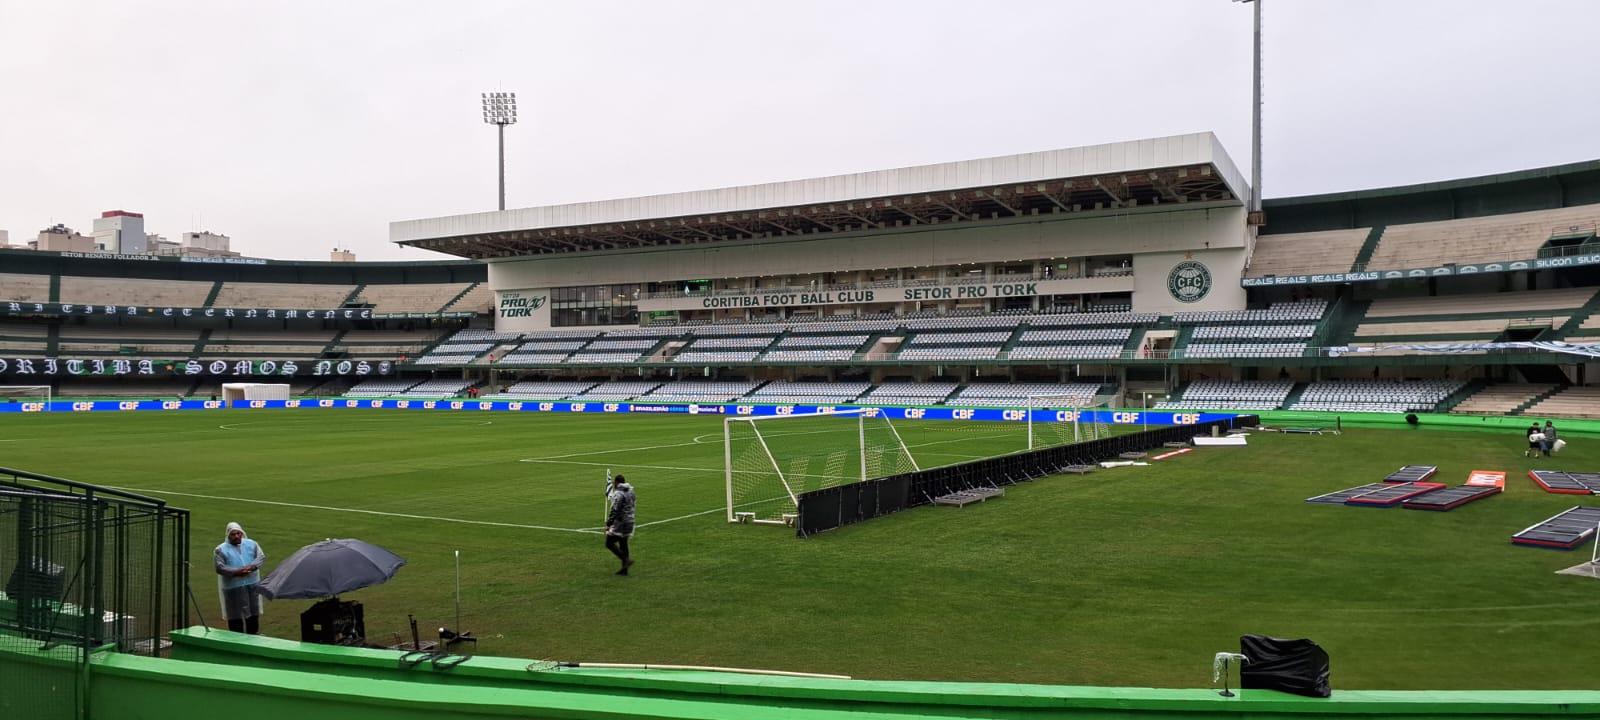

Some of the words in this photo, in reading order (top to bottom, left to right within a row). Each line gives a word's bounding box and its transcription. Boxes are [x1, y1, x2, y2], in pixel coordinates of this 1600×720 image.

[1242, 277, 1274, 286] REALS
[1275, 275, 1307, 284] REALS
[1311, 274, 1344, 283] REALS
[1345, 271, 1378, 281] REALS
[702, 296, 760, 308] CORITIBA
[763, 294, 797, 306] FOOT
[800, 292, 834, 304] BALL
[837, 290, 874, 303] CLUB
[904, 287, 951, 300] SETOR
[957, 285, 988, 298] PRO
[992, 283, 1038, 296] TORK
[500, 298, 527, 308] PRO
[500, 308, 532, 318] TORK
[185, 360, 298, 375] SOMOS
[22, 402, 45, 412] CBF
[73, 402, 95, 411] CBF
[120, 401, 139, 410] CBF
[163, 401, 182, 409] CBF
[539, 403, 554, 411] CBF
[571, 403, 586, 411] CBF
[604, 404, 619, 412] CBF
[737, 406, 754, 414] CBF
[776, 406, 794, 415] CBF
[905, 409, 926, 418] CBF
[953, 409, 975, 419] CBF
[1003, 410, 1026, 420] CBF
[1057, 410, 1081, 422] CBF
[1113, 412, 1139, 423] CBF
[1173, 413, 1201, 424] CBF
